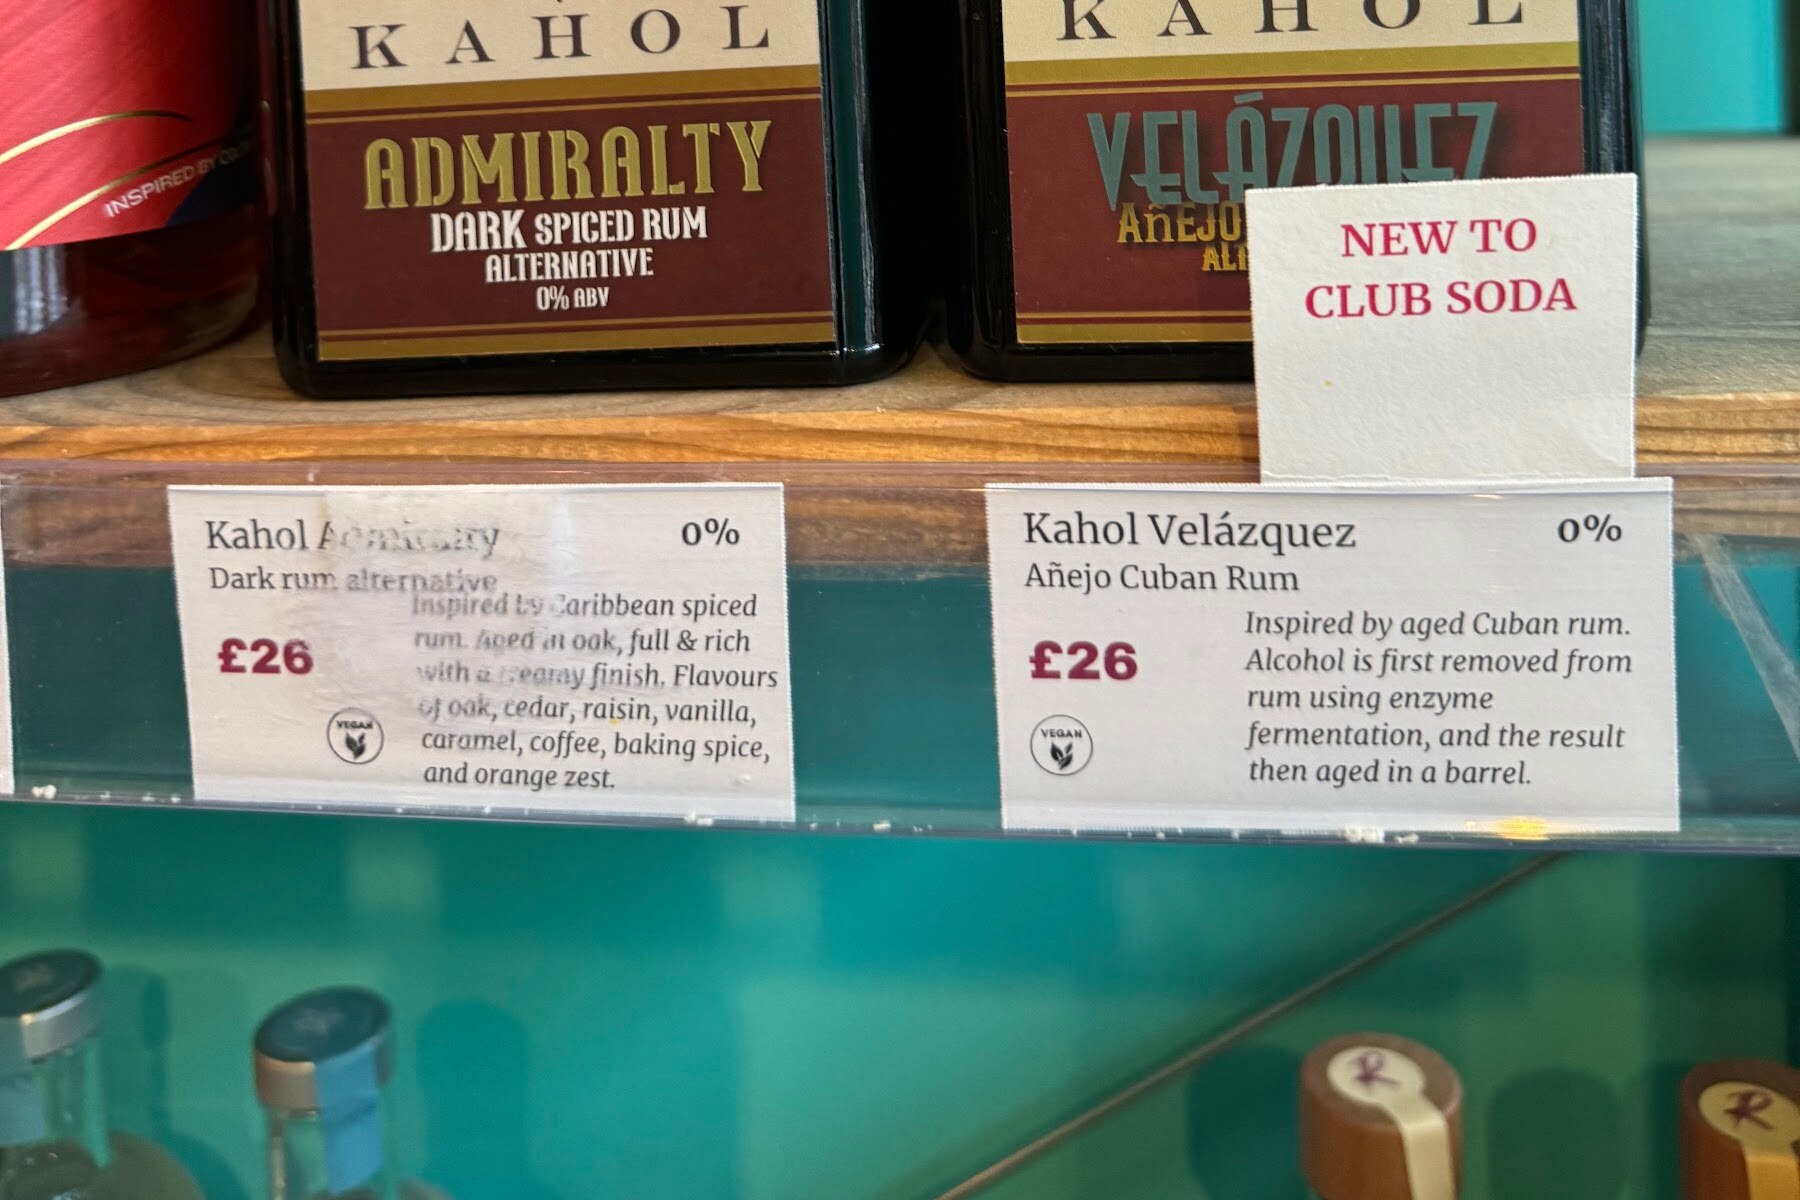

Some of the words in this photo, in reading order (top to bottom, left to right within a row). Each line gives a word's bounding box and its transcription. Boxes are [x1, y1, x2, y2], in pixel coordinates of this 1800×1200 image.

[348, 5, 769, 69] KAHOL
[365, 120, 771, 209] ADMIRALTY
[105, 165, 193, 217] INSPIRED
[430, 209, 527, 252] DARK
[534, 209, 634, 246] SPICED
[643, 207, 708, 241] RUM
[1341, 222, 1457, 257] NEW
[1469, 218, 1537, 252] TO
[485, 248, 654, 283] ALTERNATIVE
[536, 286, 569, 311] 0%
[575, 286, 609, 309] ABV
[1305, 282, 1431, 318] CLUB
[1446, 278, 1577, 314] SODA
[205, 518, 307, 551] Kahol
[681, 518, 740, 547] 0%
[1023, 511, 1138, 548] Kahol
[1148, 511, 1356, 555] Velázquez
[1557, 514, 1623, 544] 0%
[208, 566, 275, 590] Dark
[281, 571, 336, 590] rum
[346, 567, 497, 592] alternative
[1024, 562, 1112, 594] Añejo
[1120, 565, 1217, 591] Cuban
[1226, 566, 1299, 592] Rum
[681, 594, 757, 621] spiced
[1245, 610, 1355, 641] Inspired
[1363, 611, 1392, 642] by
[1401, 613, 1465, 642] aged
[1472, 613, 1560, 637] Cuban
[1568, 618, 1630, 637] rum.
[217, 637, 313, 674] £26
[572, 628, 622, 656] oak,
[629, 628, 669, 658] full
[677, 631, 697, 652] &
[704, 629, 751, 654] rich
[590, 661, 665, 691] finish.
[673, 664, 778, 689] Flavours
[1029, 640, 1138, 681] £26
[1245, 648, 1345, 674] Alcohol
[1353, 650, 1372, 674] is
[1380, 649, 1434, 679] first
[1441, 650, 1558, 675] removed
[1565, 651, 1631, 679] from
[448, 694, 498, 721] oak,
[504, 695, 576, 723] cedar,
[583, 697, 659, 726] raisin,
[666, 698, 757, 728] vanilla,
[1248, 689, 1301, 710] rum
[1310, 686, 1381, 715] using
[1390, 690, 1493, 716] enzyme
[421, 728, 524, 758] caramel,
[529, 730, 606, 761] coffee,
[613, 732, 696, 764] baking
[703, 735, 770, 764] spice,
[1040, 728, 1083, 738] VEGAN
[1244, 721, 1431, 752] fermentation,
[1439, 724, 1491, 748] and
[1499, 724, 1541, 748] the
[1549, 725, 1624, 750] result
[423, 761, 468, 785] and
[475, 764, 557, 791] orange
[563, 768, 615, 790] zest.
[1249, 758, 1308, 784] then
[1315, 759, 1379, 788] aged
[1387, 761, 1413, 785] in
[1420, 765, 1436, 785] a
[1444, 761, 1531, 787] barrel.
